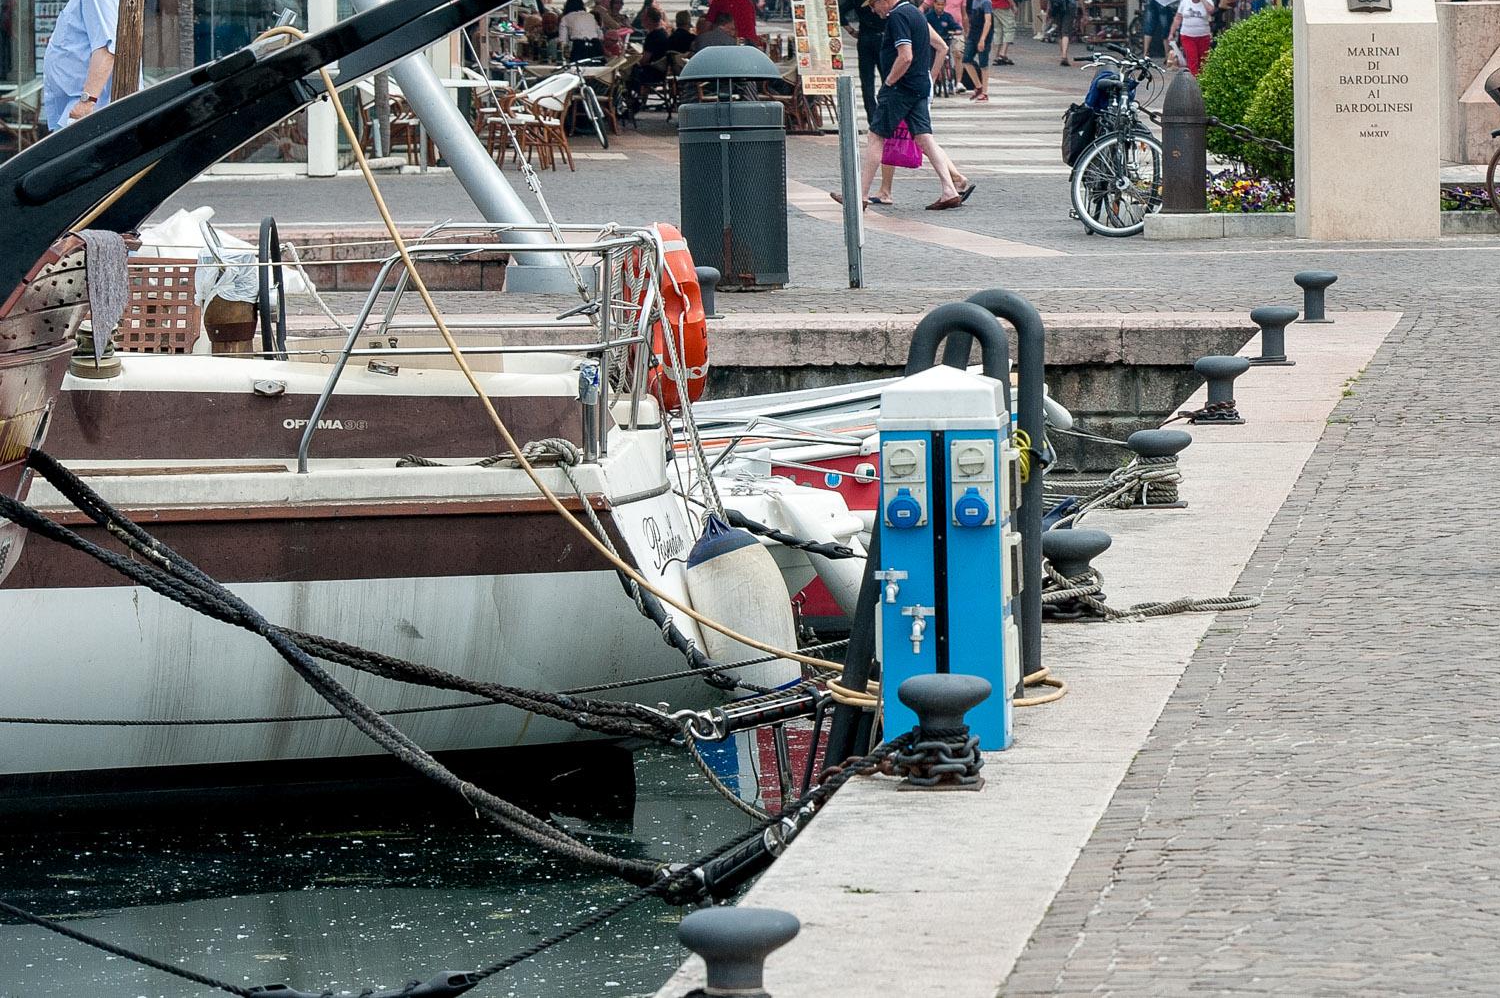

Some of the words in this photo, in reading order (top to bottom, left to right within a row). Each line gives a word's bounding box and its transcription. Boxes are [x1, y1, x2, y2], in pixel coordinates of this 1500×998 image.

[1371, 32, 1375, 43] I
[1347, 46, 1401, 57] MARINAI
[1367, 61, 1380, 71] DI
[1339, 74, 1409, 85] BARDOLINO
[1367, 89, 1380, 99] AI
[1335, 102, 1413, 113] BARDOLINESI
[1359, 130, 1390, 138] MMXIV
[282, 418, 344, 430] OPTMA
